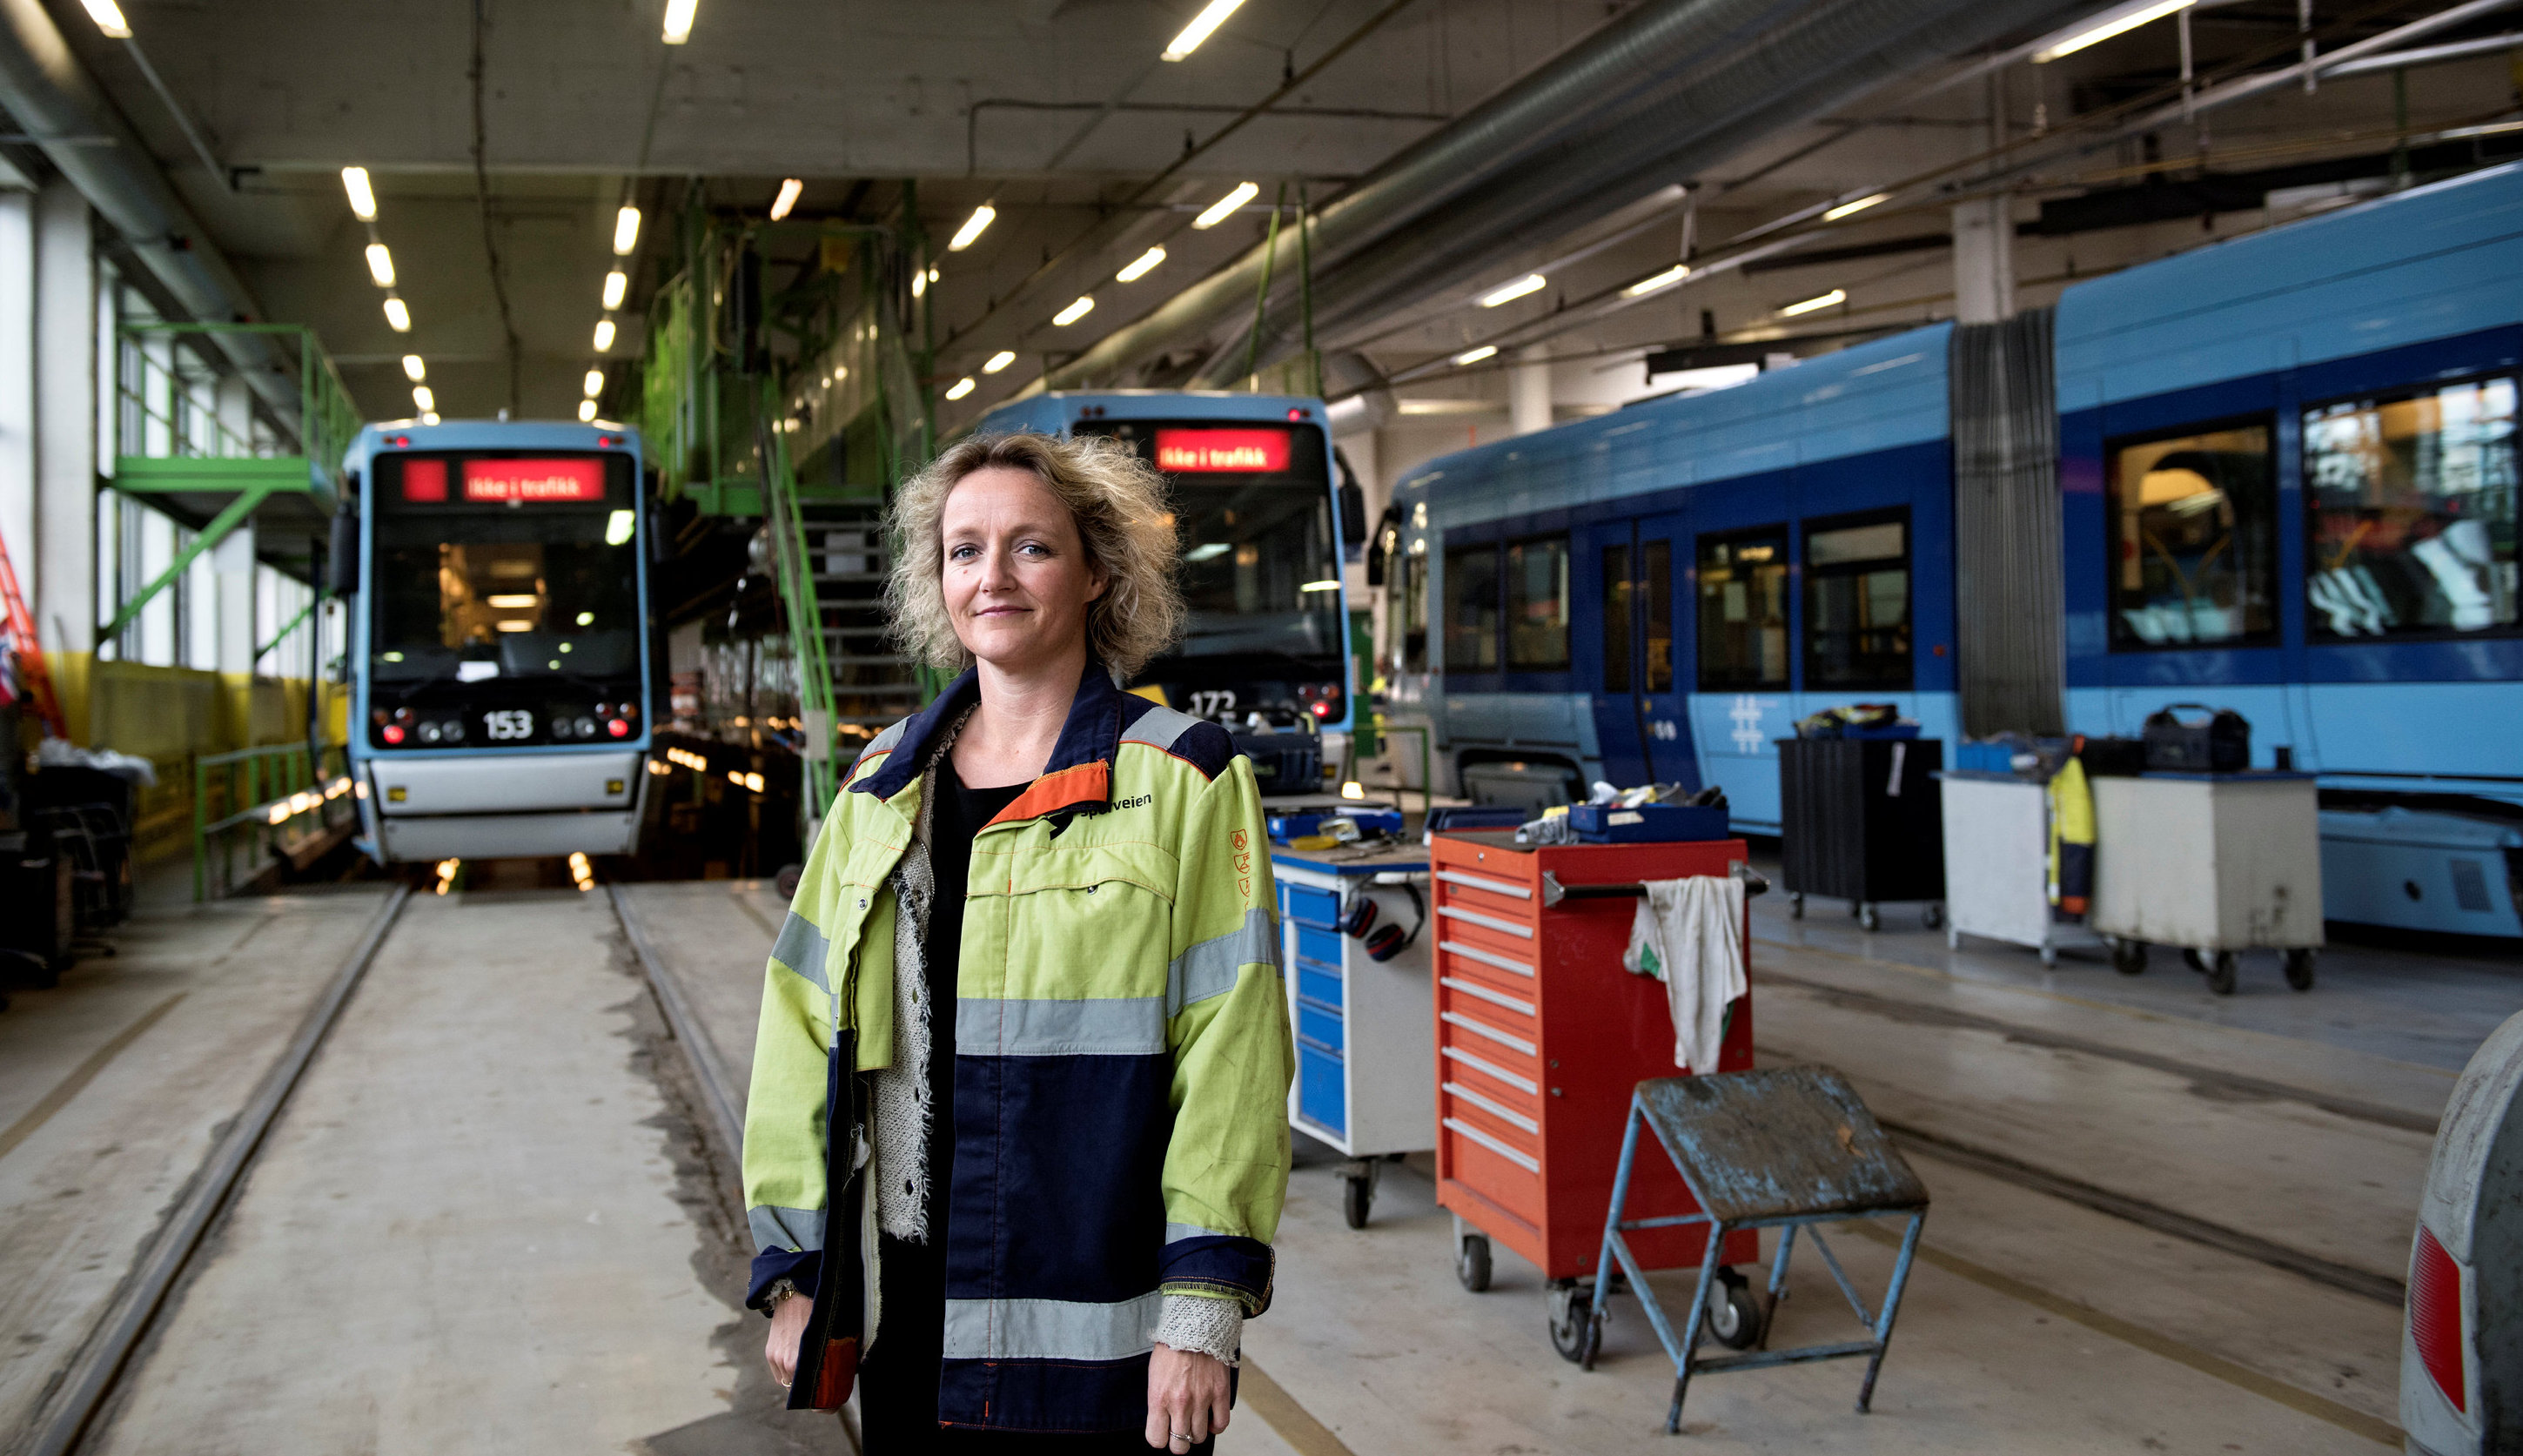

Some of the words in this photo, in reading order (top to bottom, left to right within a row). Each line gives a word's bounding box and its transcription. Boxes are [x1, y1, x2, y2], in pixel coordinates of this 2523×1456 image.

[1160, 446, 1198, 467] Ikke
[1199, 446, 1208, 467] i
[1210, 446, 1268, 467] trafikk
[467, 476, 508, 497] Ikke
[510, 476, 520, 497] i
[520, 476, 582, 497] trafikk
[1189, 689, 1237, 720] 172
[483, 709, 534, 741] 153
